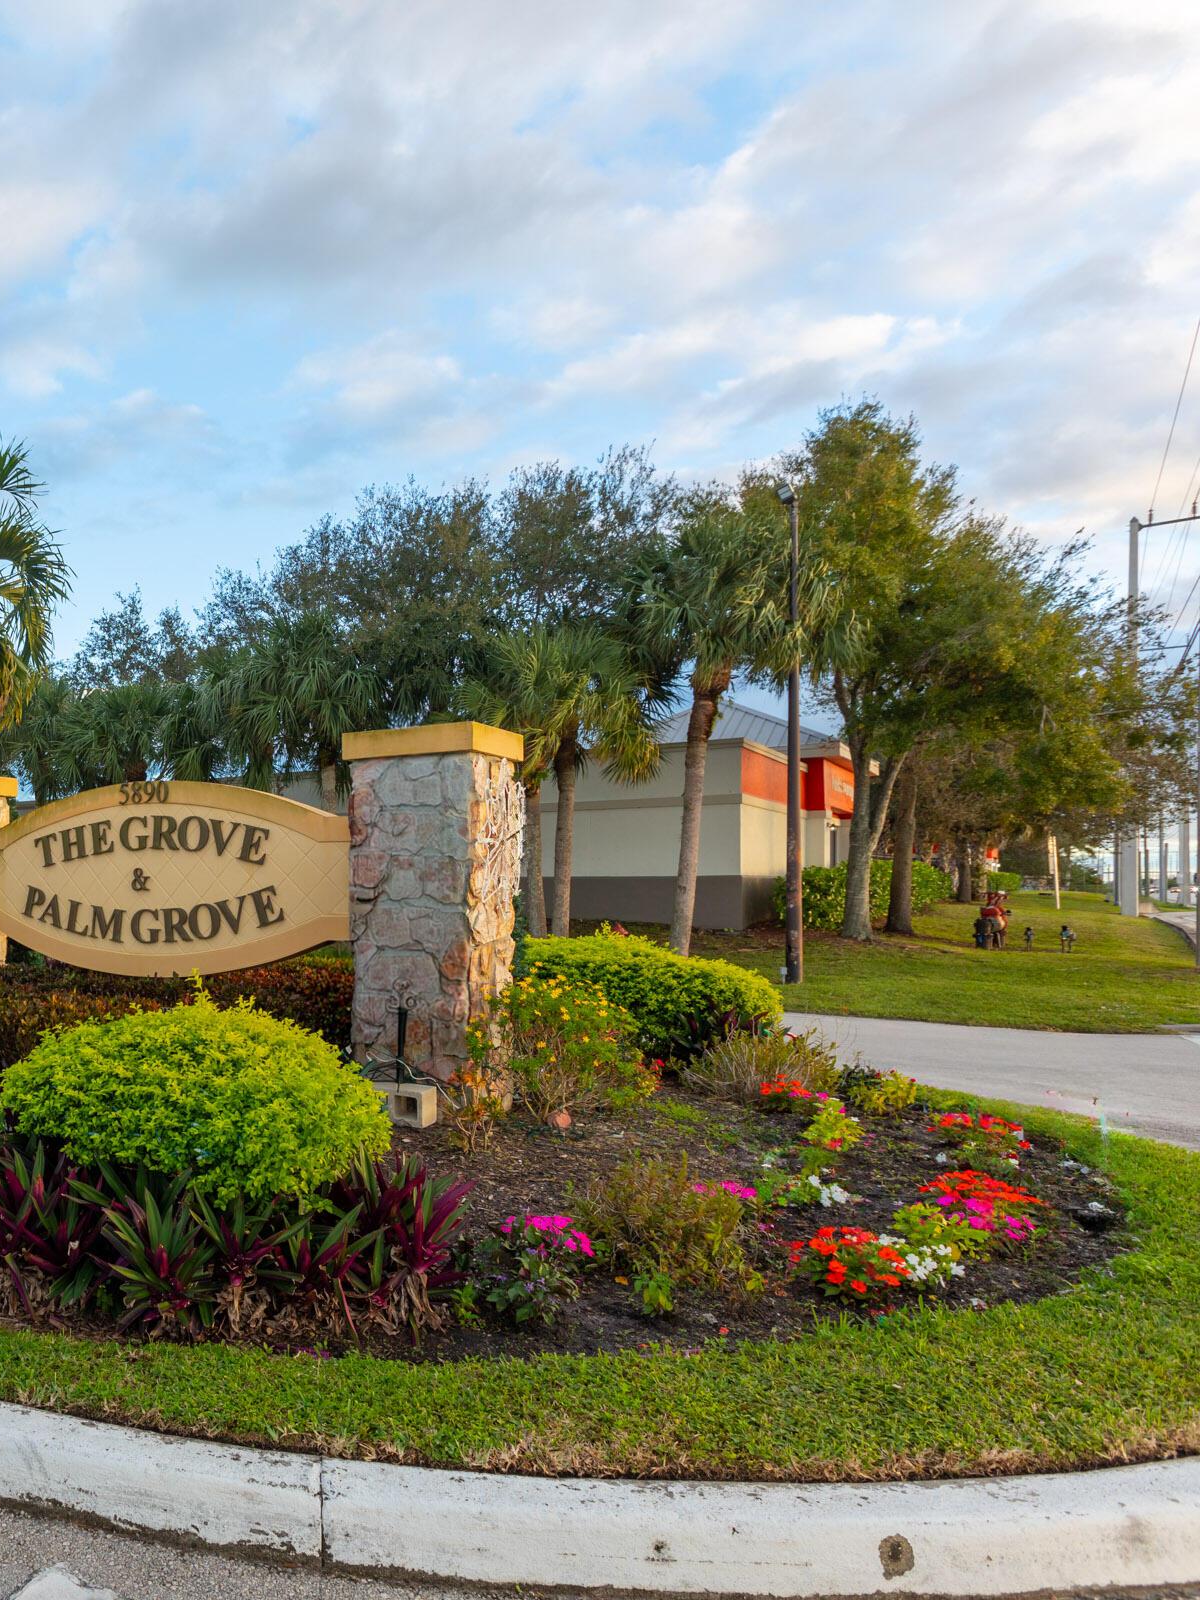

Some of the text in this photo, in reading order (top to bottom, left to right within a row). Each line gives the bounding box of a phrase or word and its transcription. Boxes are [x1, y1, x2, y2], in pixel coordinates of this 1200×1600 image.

[119, 781, 170, 805] 5890
[34, 815, 269, 868] THE GROVE
[131, 867, 150, 891] &
[21, 885, 285, 945] PALM GROVE
